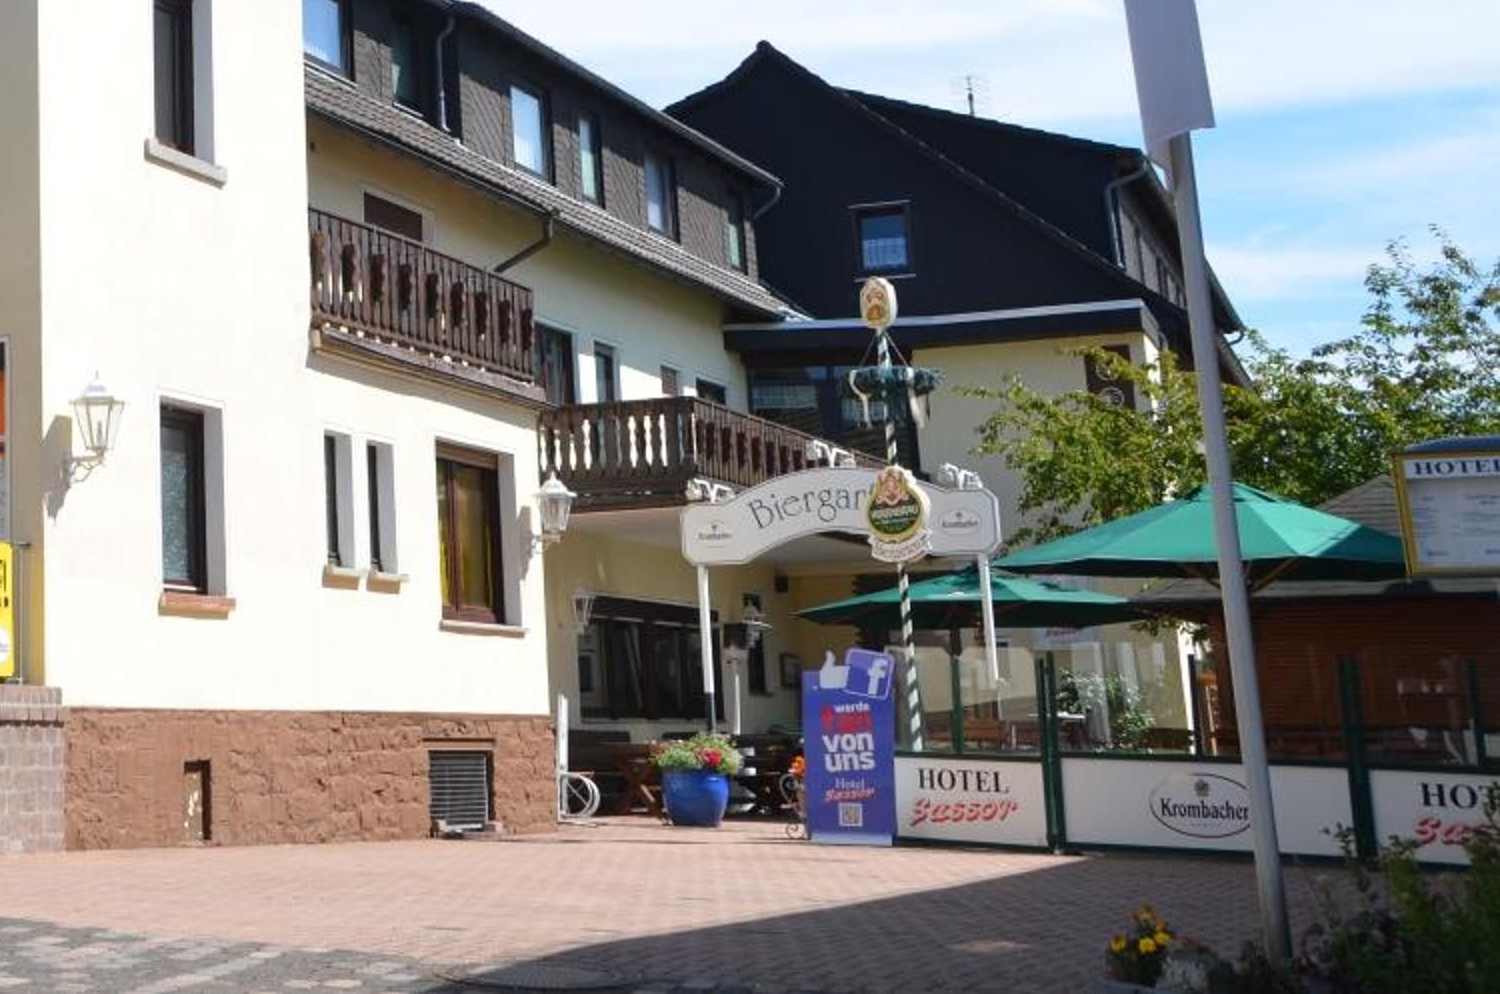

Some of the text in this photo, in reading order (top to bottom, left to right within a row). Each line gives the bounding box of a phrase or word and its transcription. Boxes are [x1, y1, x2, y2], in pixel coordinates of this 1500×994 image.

[748, 488, 868, 529] Biergar
[822, 732, 875, 754] von
[825, 751, 876, 772] uns
[918, 767, 1010, 794] HOTEL
[910, 797, 1018, 827] Sassor
[1160, 797, 1249, 821] Krombacher
